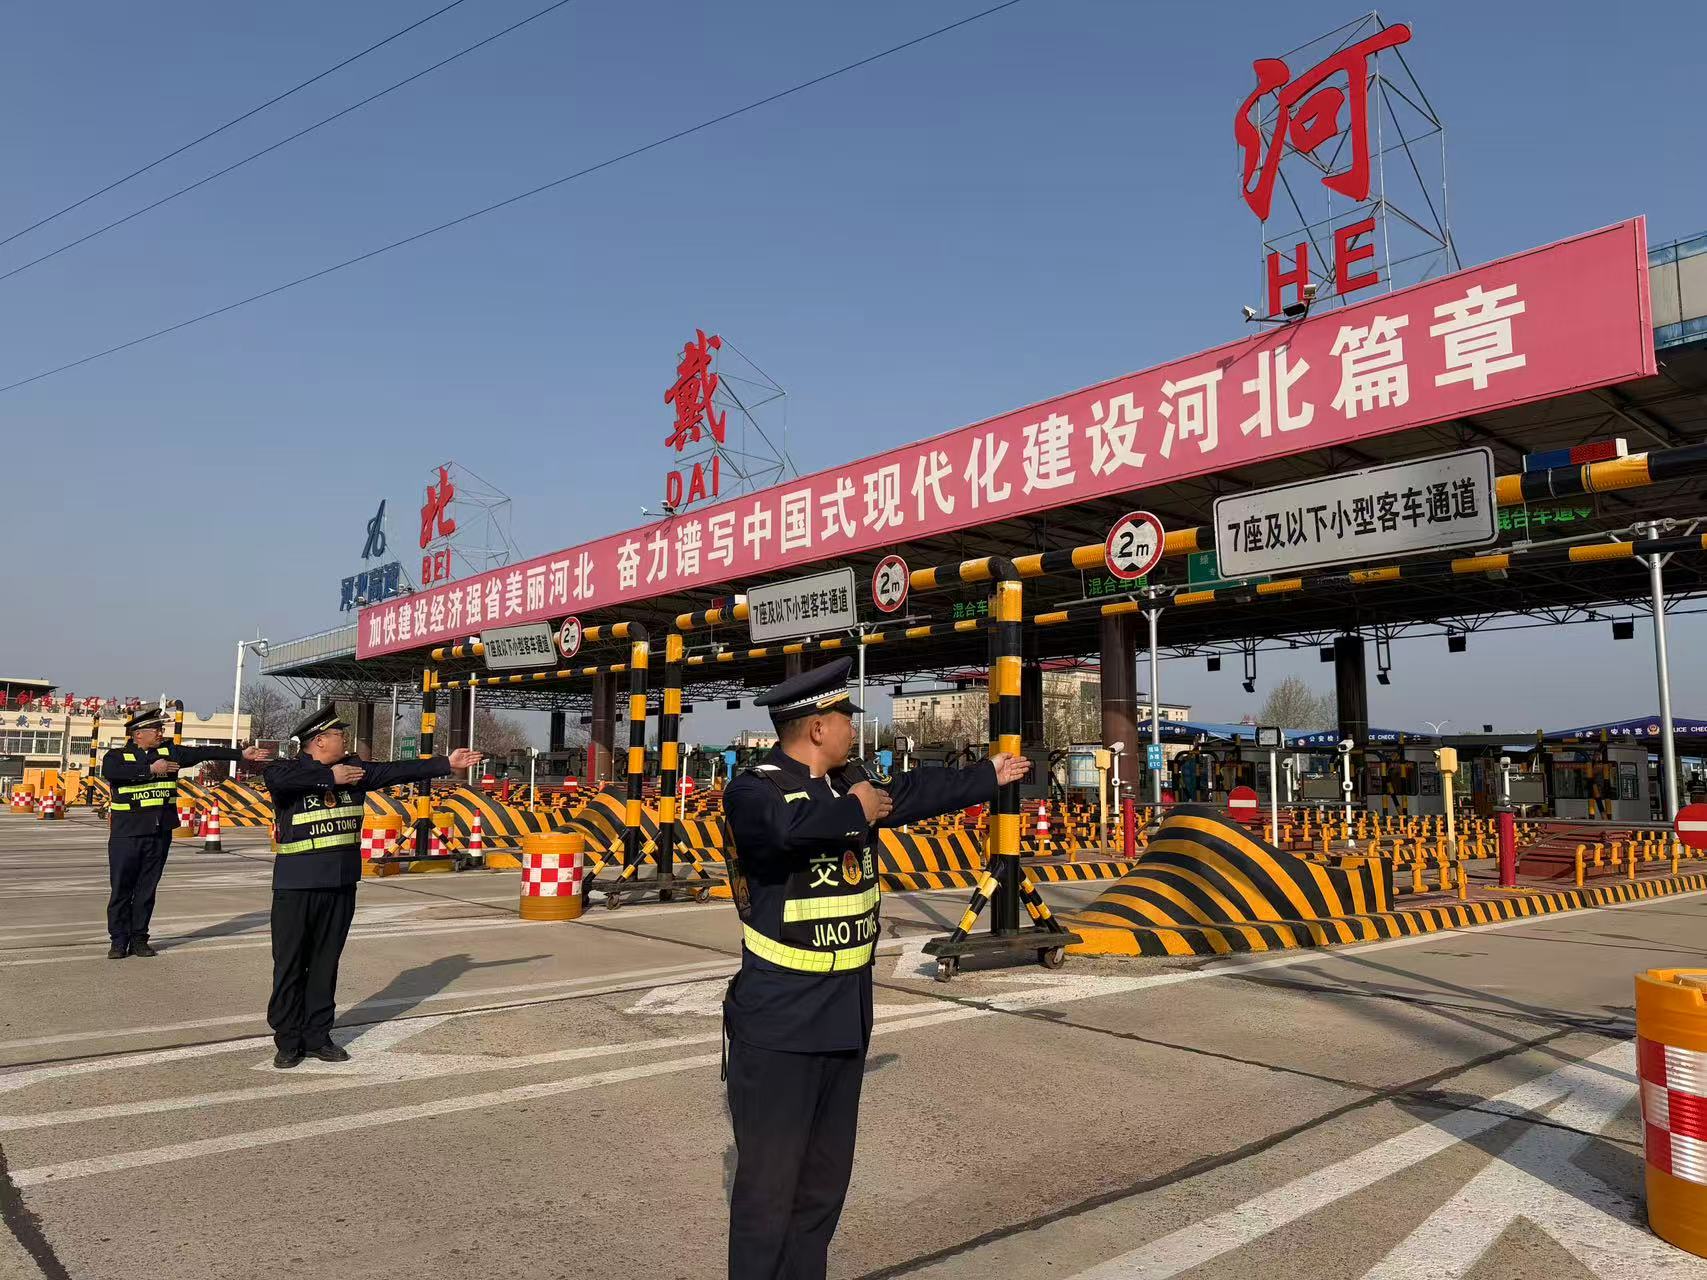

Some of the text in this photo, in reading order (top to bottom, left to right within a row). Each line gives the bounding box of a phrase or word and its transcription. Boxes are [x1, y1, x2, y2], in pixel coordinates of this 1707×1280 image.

[1234, 23, 1411, 222] 河
[1267, 217, 1378, 316] HE
[664, 328, 726, 452] 戴
[368, 283, 1526, 648] 加快建设经济强省美丽河北 奋力谱写中国式现代化建设河北篇章
[666, 456, 720, 508] DAI
[420, 466, 456, 549] 北
[1228, 477, 1479, 553] 7座及以下小型客车通道
[1117, 531, 1150, 558] 2m
[422, 549, 451, 585] BEI
[880, 572, 900, 594] 2m
[753, 586, 849, 626] 7座及以下小型客车通道
[953, 600, 988, 618] 混合车
[131, 790, 170, 801] JIAO TONG
[309, 819, 357, 836] JIAO TONG
[809, 853, 840, 889] 交
[812, 921, 851, 948] JIAO
